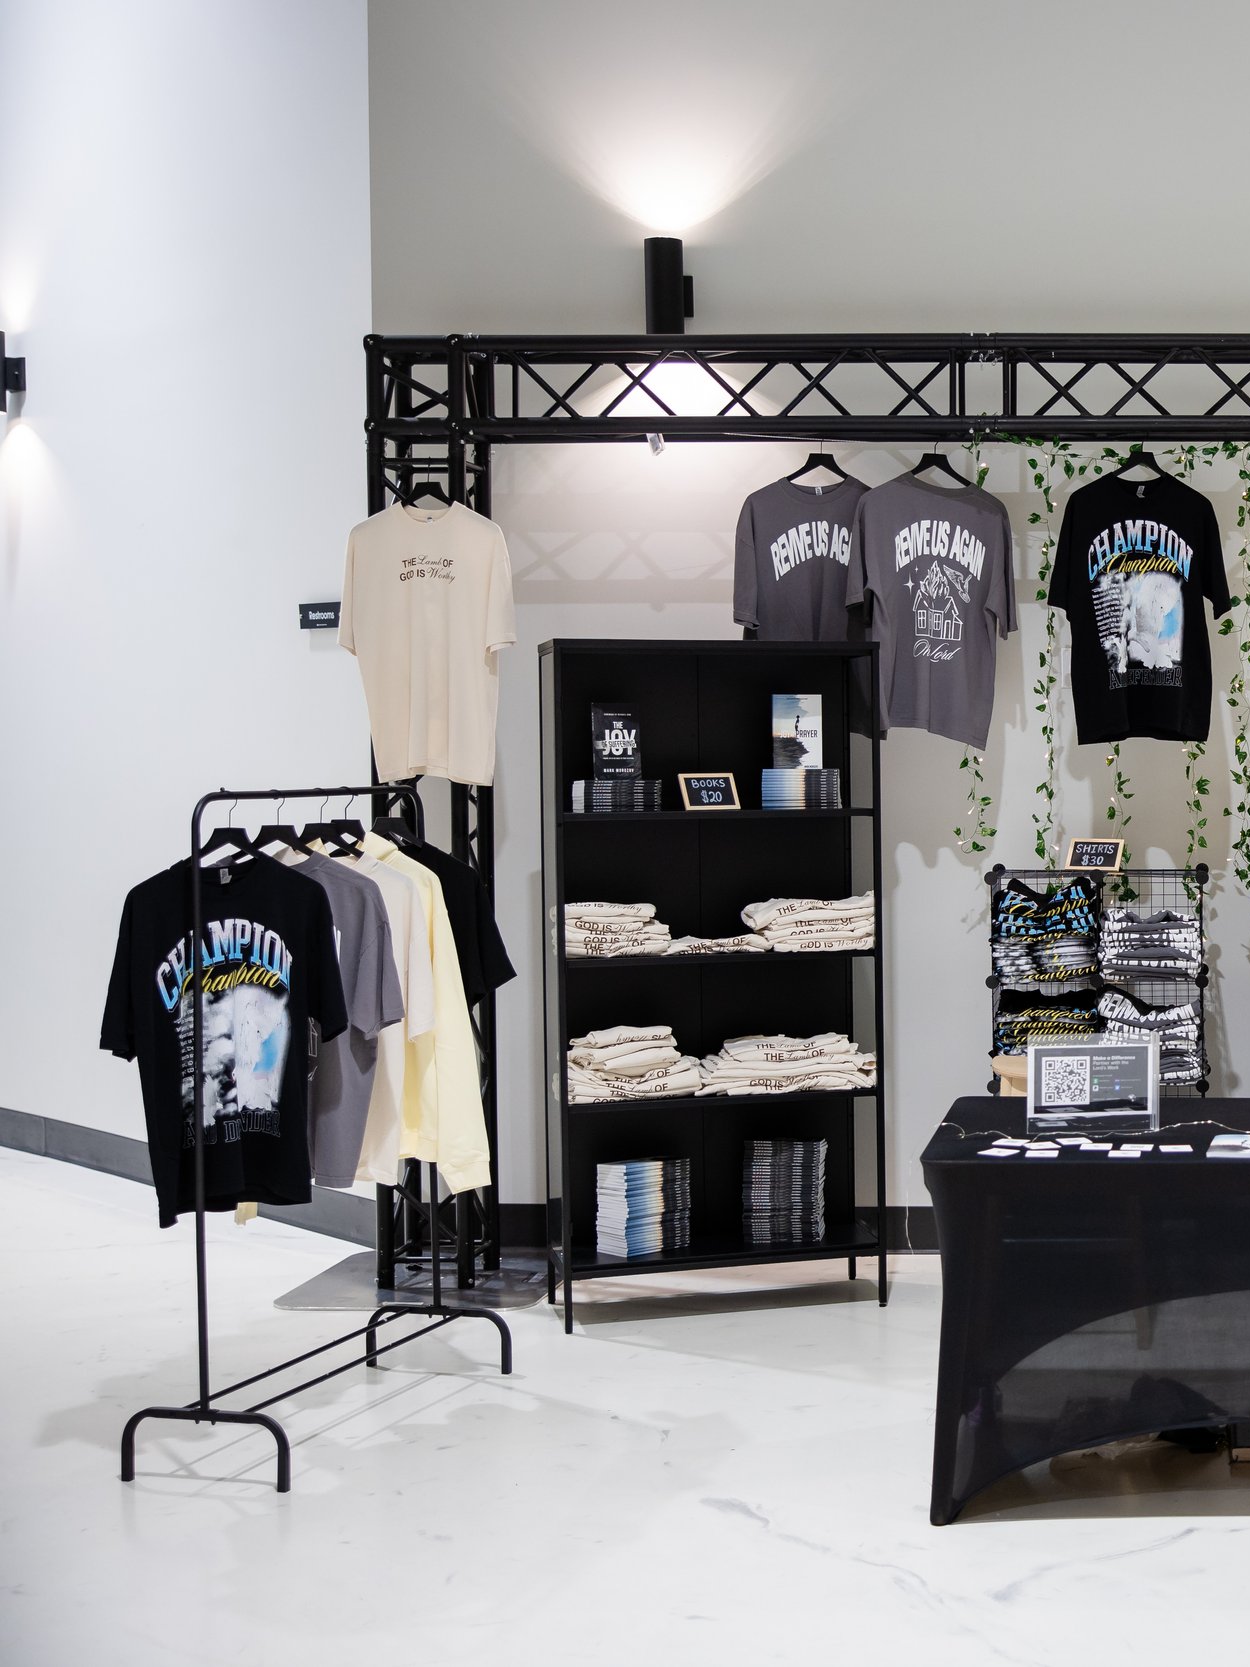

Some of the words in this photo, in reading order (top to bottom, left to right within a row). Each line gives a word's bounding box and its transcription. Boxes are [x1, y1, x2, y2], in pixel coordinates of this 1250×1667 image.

[770, 522, 813, 581] REVIVE
[814, 520, 830, 557] US
[895, 520, 931, 572] REVIVE
[931, 520, 950, 557] US
[950, 525, 986, 581] AGAIN
[1088, 519, 1194, 582] CHAMPION
[402, 557, 417, 568] THE
[417, 554, 442, 566] Lamb
[442, 558, 454, 568] OF
[1103, 553, 1179, 579] Champion
[400, 569, 414, 582] GOD
[416, 569, 426, 578] IS
[427, 567, 455, 584] Worthy
[309, 611, 335, 620] Restrooms
[613, 721, 623, 729] THE
[796, 730, 818, 738] PRAYER
[603, 729, 636, 755] JOY
[691, 778, 726, 789] BOOKS
[700, 790, 723, 804] $20
[1076, 843, 1115, 854] SHIRTS
[1081, 855, 1104, 866] $30
[776, 903, 797, 916] THE
[575, 921, 599, 931] GOD
[732, 937, 745, 945] OF
[155, 918, 293, 1013] CHAMPION
[764, 1053, 785, 1061] THE
[811, 1049, 825, 1058] OF
[657, 1069, 670, 1077] OF
[654, 1083, 668, 1092] OF
